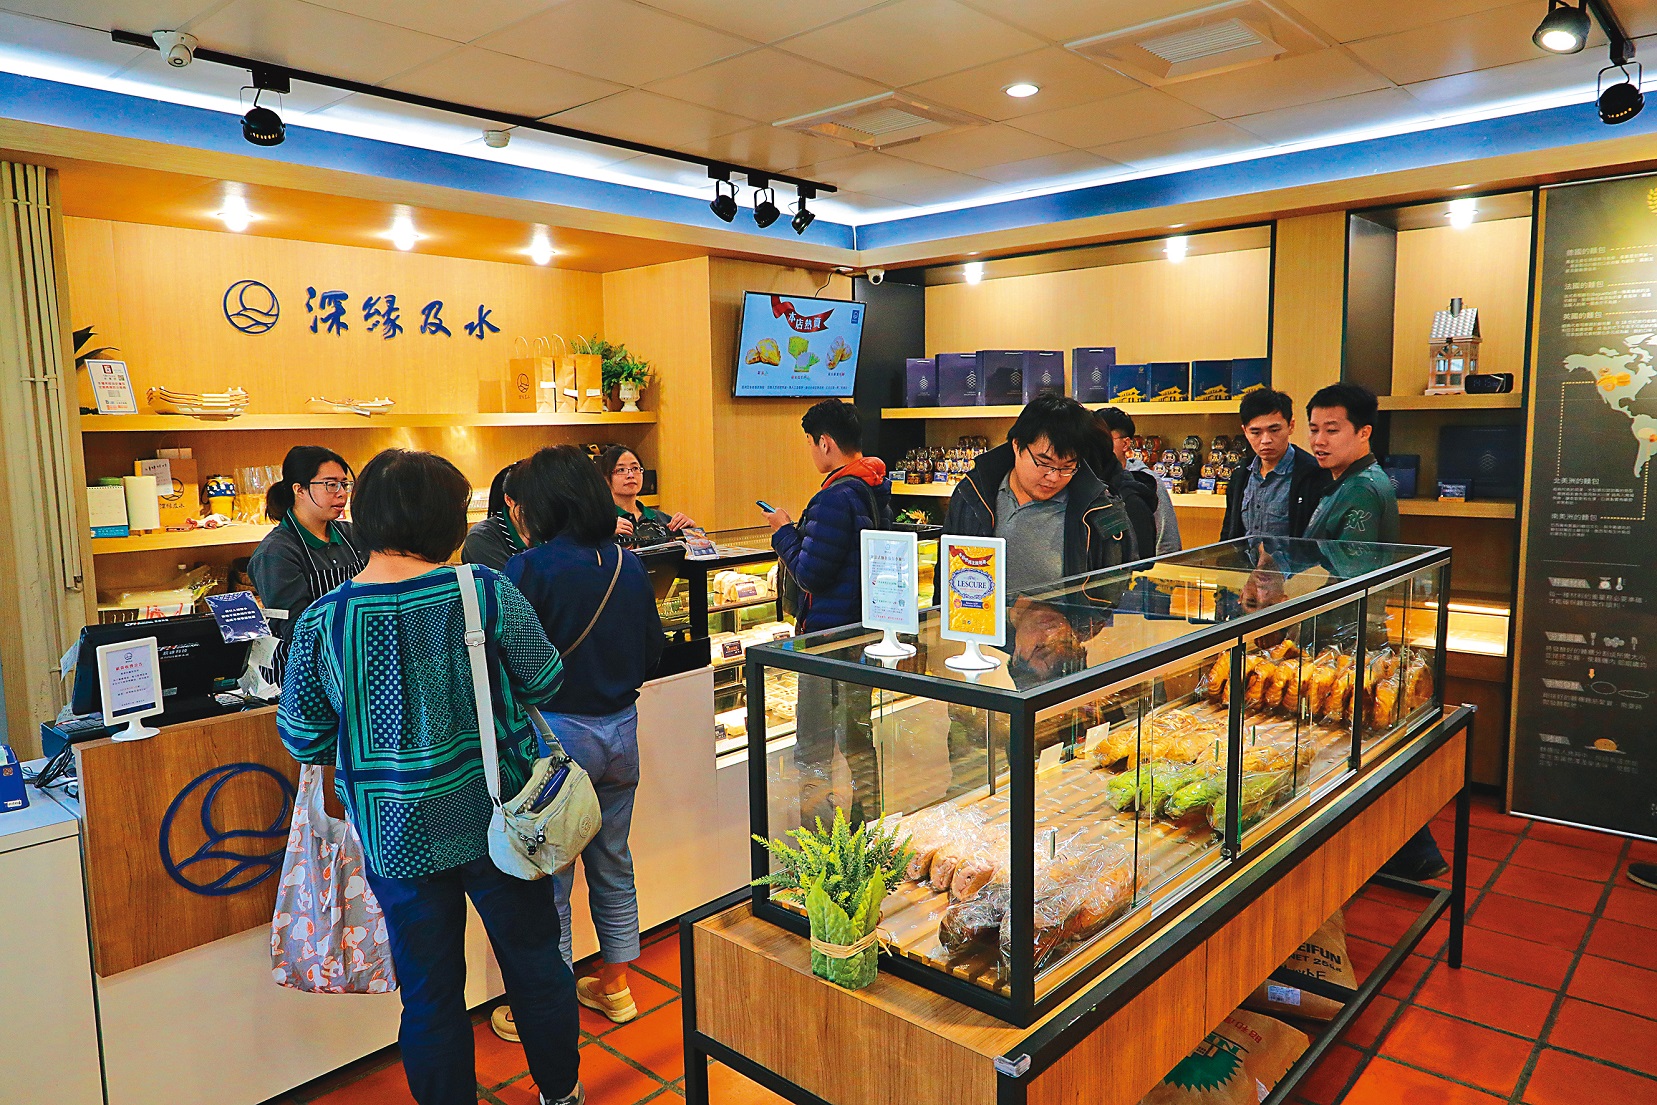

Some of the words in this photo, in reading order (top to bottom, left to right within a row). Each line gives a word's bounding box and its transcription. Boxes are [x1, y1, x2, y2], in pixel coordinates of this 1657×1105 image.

[788, 312, 822, 330] 本店熱賣
[1553, 477, 1600, 485] 北美洲的麵包
[957, 580, 987, 589] LESCURE
